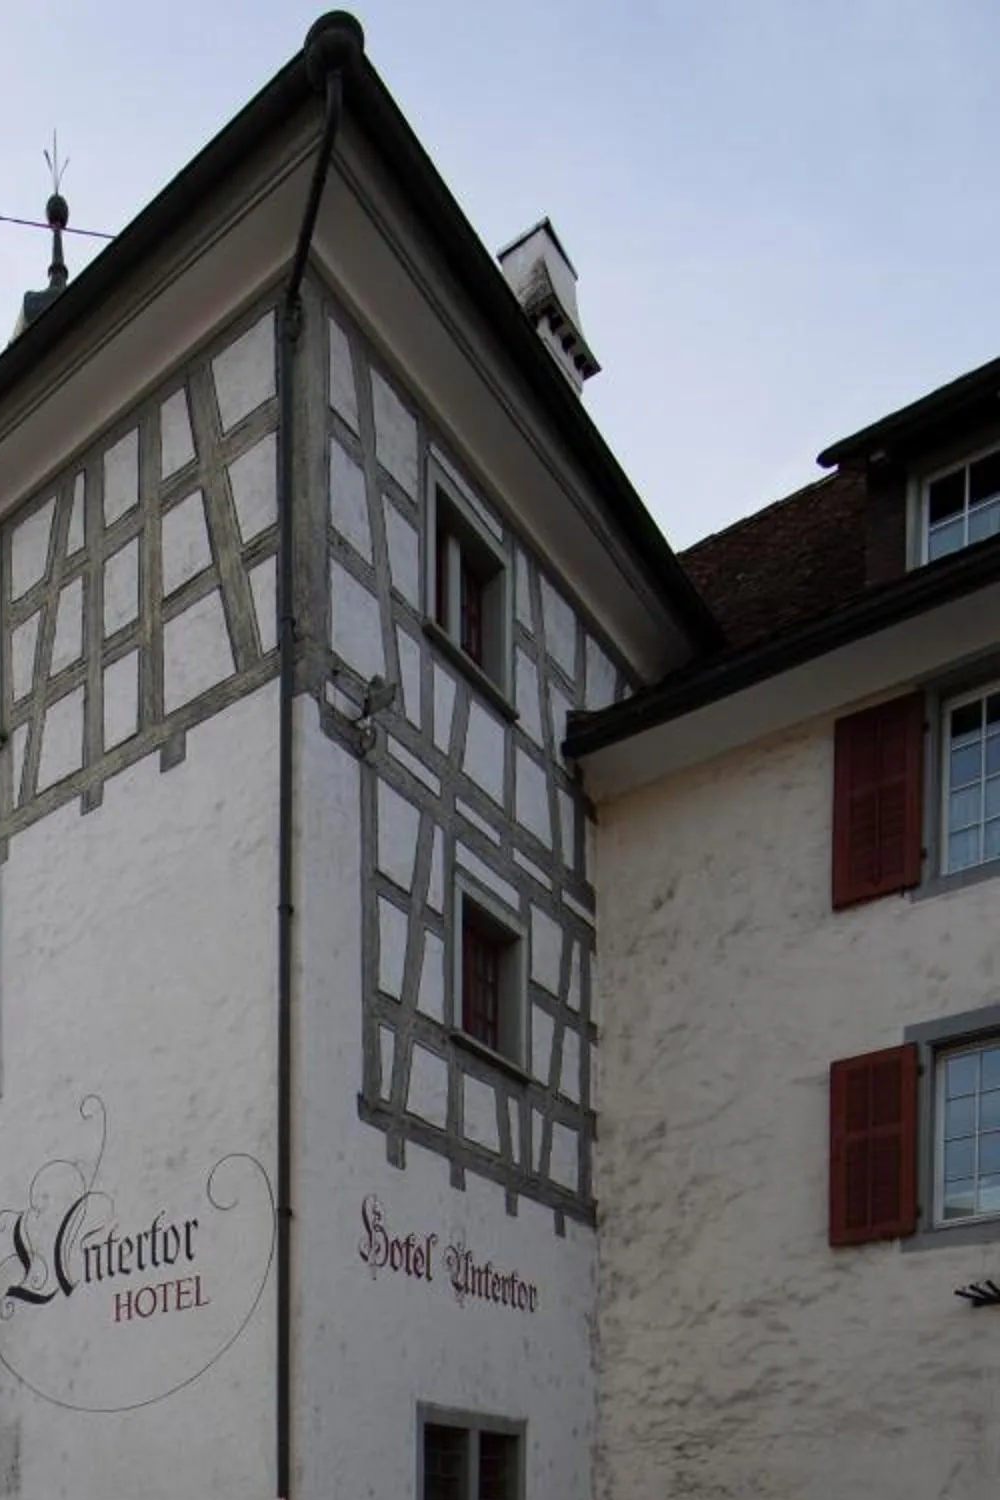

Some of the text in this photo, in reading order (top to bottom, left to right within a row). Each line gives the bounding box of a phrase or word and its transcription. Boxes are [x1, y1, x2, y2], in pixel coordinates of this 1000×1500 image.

[359, 1194, 538, 1313] Hotel Untertor
[112, 1276, 210, 1322] HOTEL
